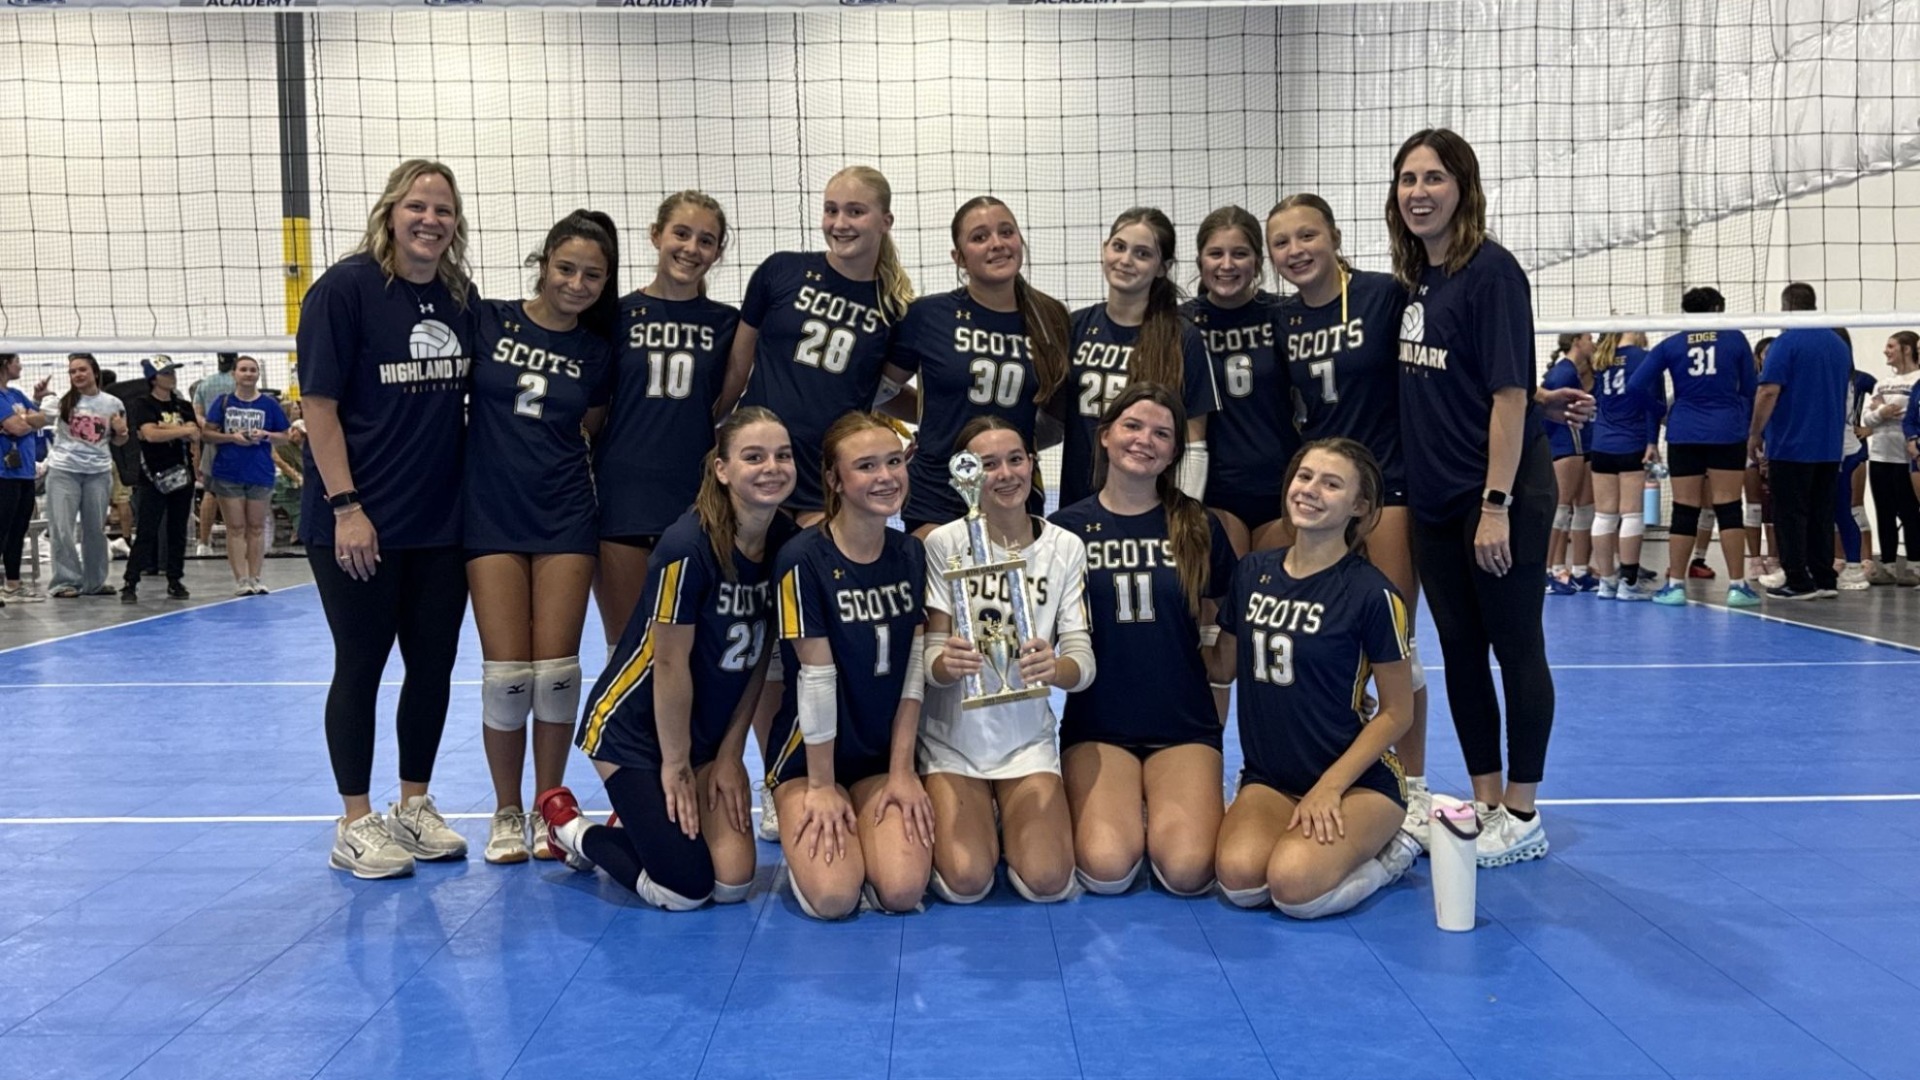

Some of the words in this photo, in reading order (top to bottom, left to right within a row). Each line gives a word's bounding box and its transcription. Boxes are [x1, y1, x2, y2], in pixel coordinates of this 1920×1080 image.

[794, 286, 881, 334] SCOTS
[492, 337, 584, 378] SCOTS
[629, 322, 715, 351] SCOTS
[793, 318, 856, 374] 28
[1073, 341, 1135, 371] SCOT
[1288, 317, 1364, 362] SCOTS
[1687, 331, 1718, 344] EDGE
[379, 359, 453, 384] HIGHLAND
[646, 351, 695, 399] 10
[967, 357, 1025, 408] 30
[1224, 352, 1253, 398] 6
[1308, 358, 1339, 404] 7
[1603, 368, 1626, 396] 14
[1687, 346, 1718, 376] 31
[513, 371, 549, 420] 2
[1087, 538, 1178, 569] SCOTS
[717, 581, 773, 616] SCOT
[836, 581, 915, 623] SCOTS
[1112, 571, 1156, 624] 11
[1246, 591, 1325, 634] SCOTS
[873, 624, 892, 678] 1
[1252, 628, 1295, 687] 13
